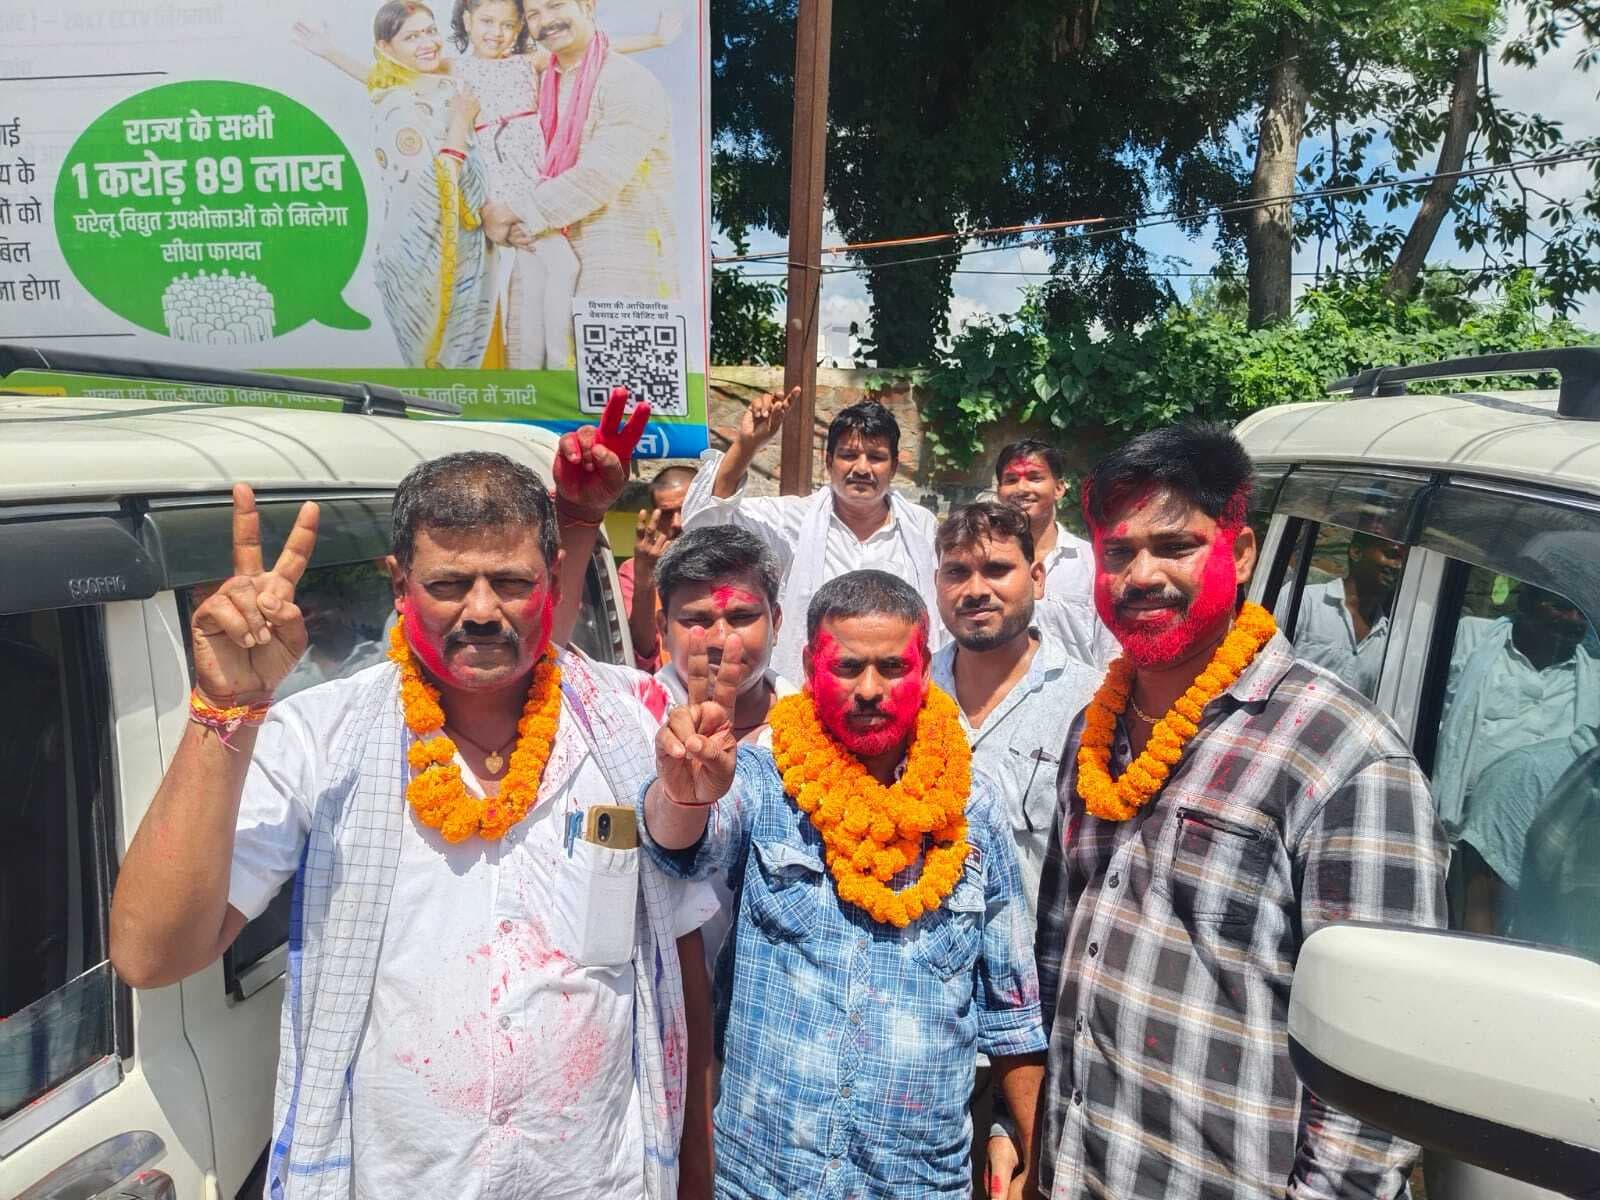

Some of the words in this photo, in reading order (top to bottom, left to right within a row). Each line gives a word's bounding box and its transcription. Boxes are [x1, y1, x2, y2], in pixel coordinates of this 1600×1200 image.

[122, 117, 183, 145] राज्य
[185, 108, 213, 142] के
[215, 105, 275, 141] सभी
[16, 157, 35, 185] के
[72, 162, 89, 199] 1
[94, 149, 188, 206] करोड़
[195, 156, 244, 195] 89
[250, 154, 346, 193] लाख
[16, 196, 42, 224] को
[73, 208, 122, 238] घरेलू
[118, 207, 162, 237] विद्युत
[164, 204, 256, 230] उपभोक्ताओं
[259, 202, 284, 228] को
[287, 201, 349, 227] मिलेगा
[160, 238, 204, 263] सीधा
[206, 241, 262, 262] फायदा
[19, 273, 61, 301] होगा
[481, 385, 498, 404] में
[500, 385, 537, 405] जारी
